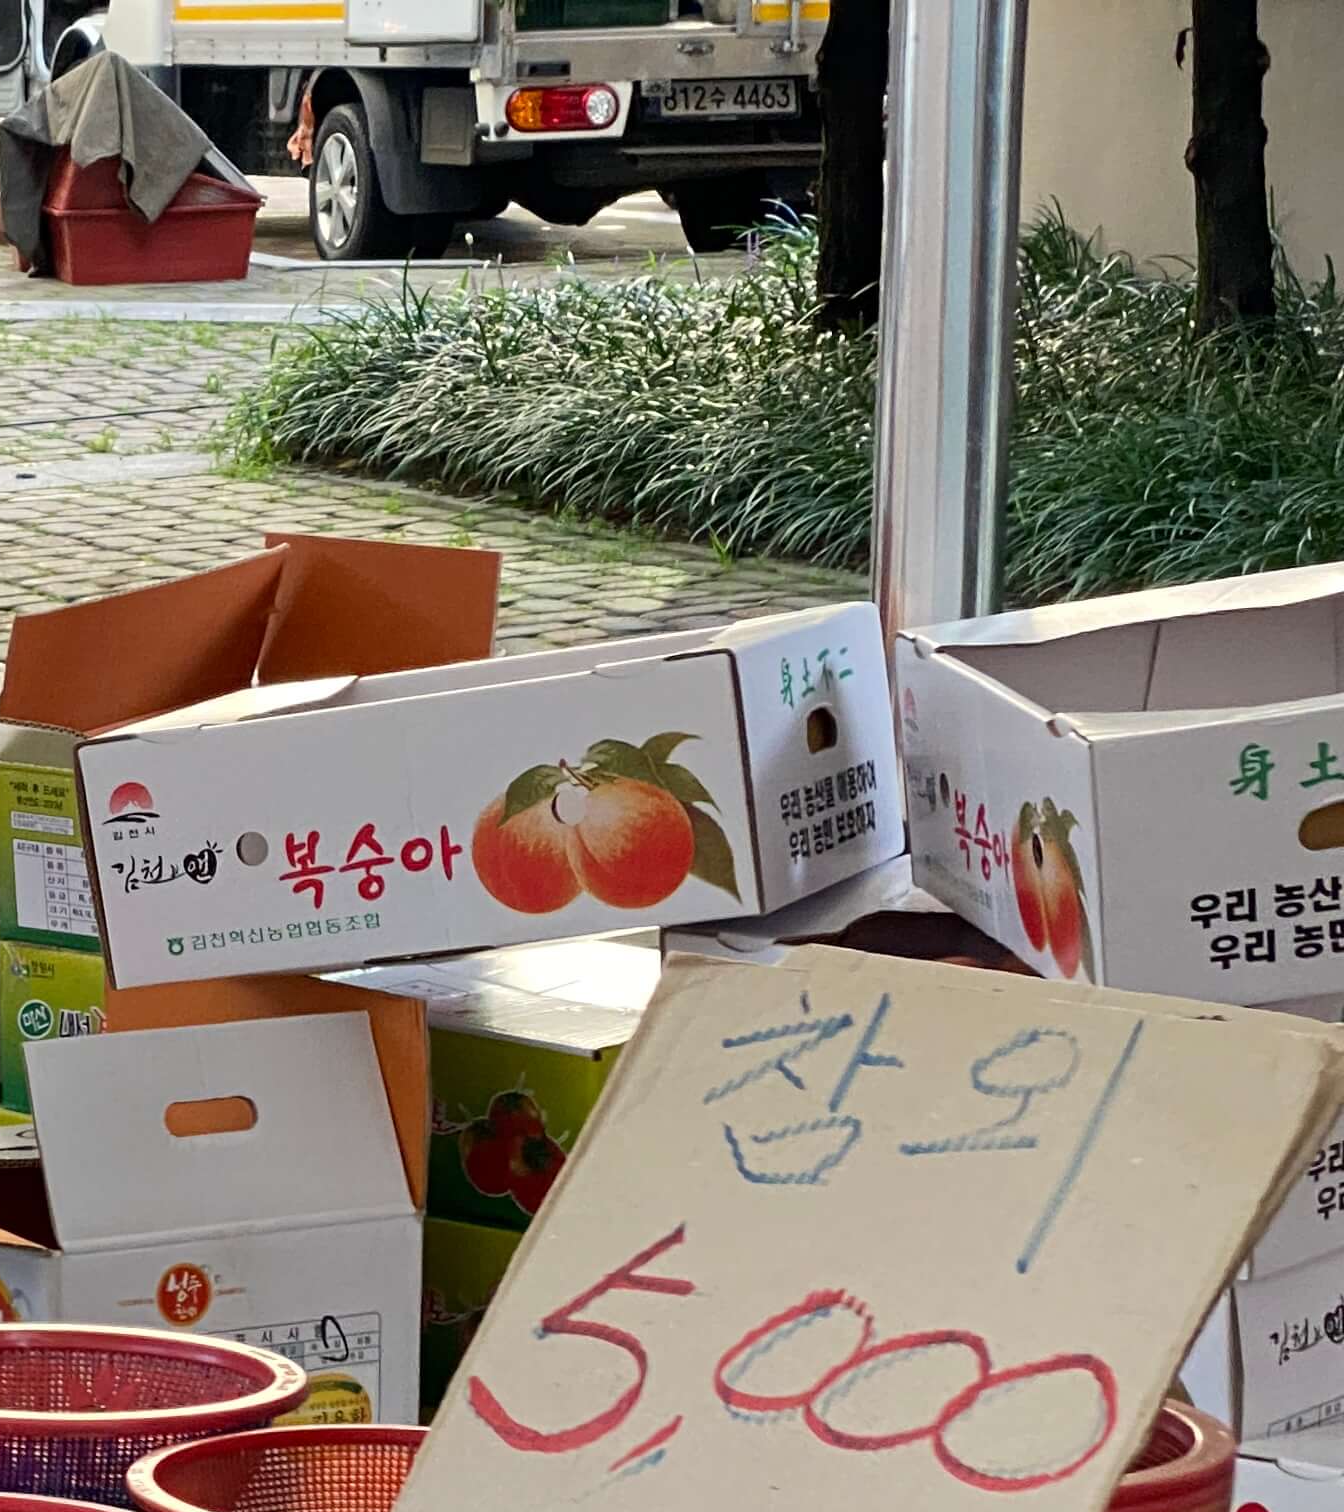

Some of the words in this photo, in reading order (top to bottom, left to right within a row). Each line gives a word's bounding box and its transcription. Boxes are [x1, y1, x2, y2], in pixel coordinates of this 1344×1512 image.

[732, 84, 771, 109] 4463
[779, 788, 802, 826] 우리
[803, 775, 836, 818] 농산물
[789, 827, 811, 865] 우리
[812, 816, 835, 855] 농민
[954, 788, 1010, 884] 복숭아
[278, 822, 464, 909] 복숭아
[1189, 887, 1258, 929] 우리
[1209, 928, 1277, 970] 우리
[703, 990, 1144, 1273] 참외
[467, 1222, 1118, 1493] 5,000
